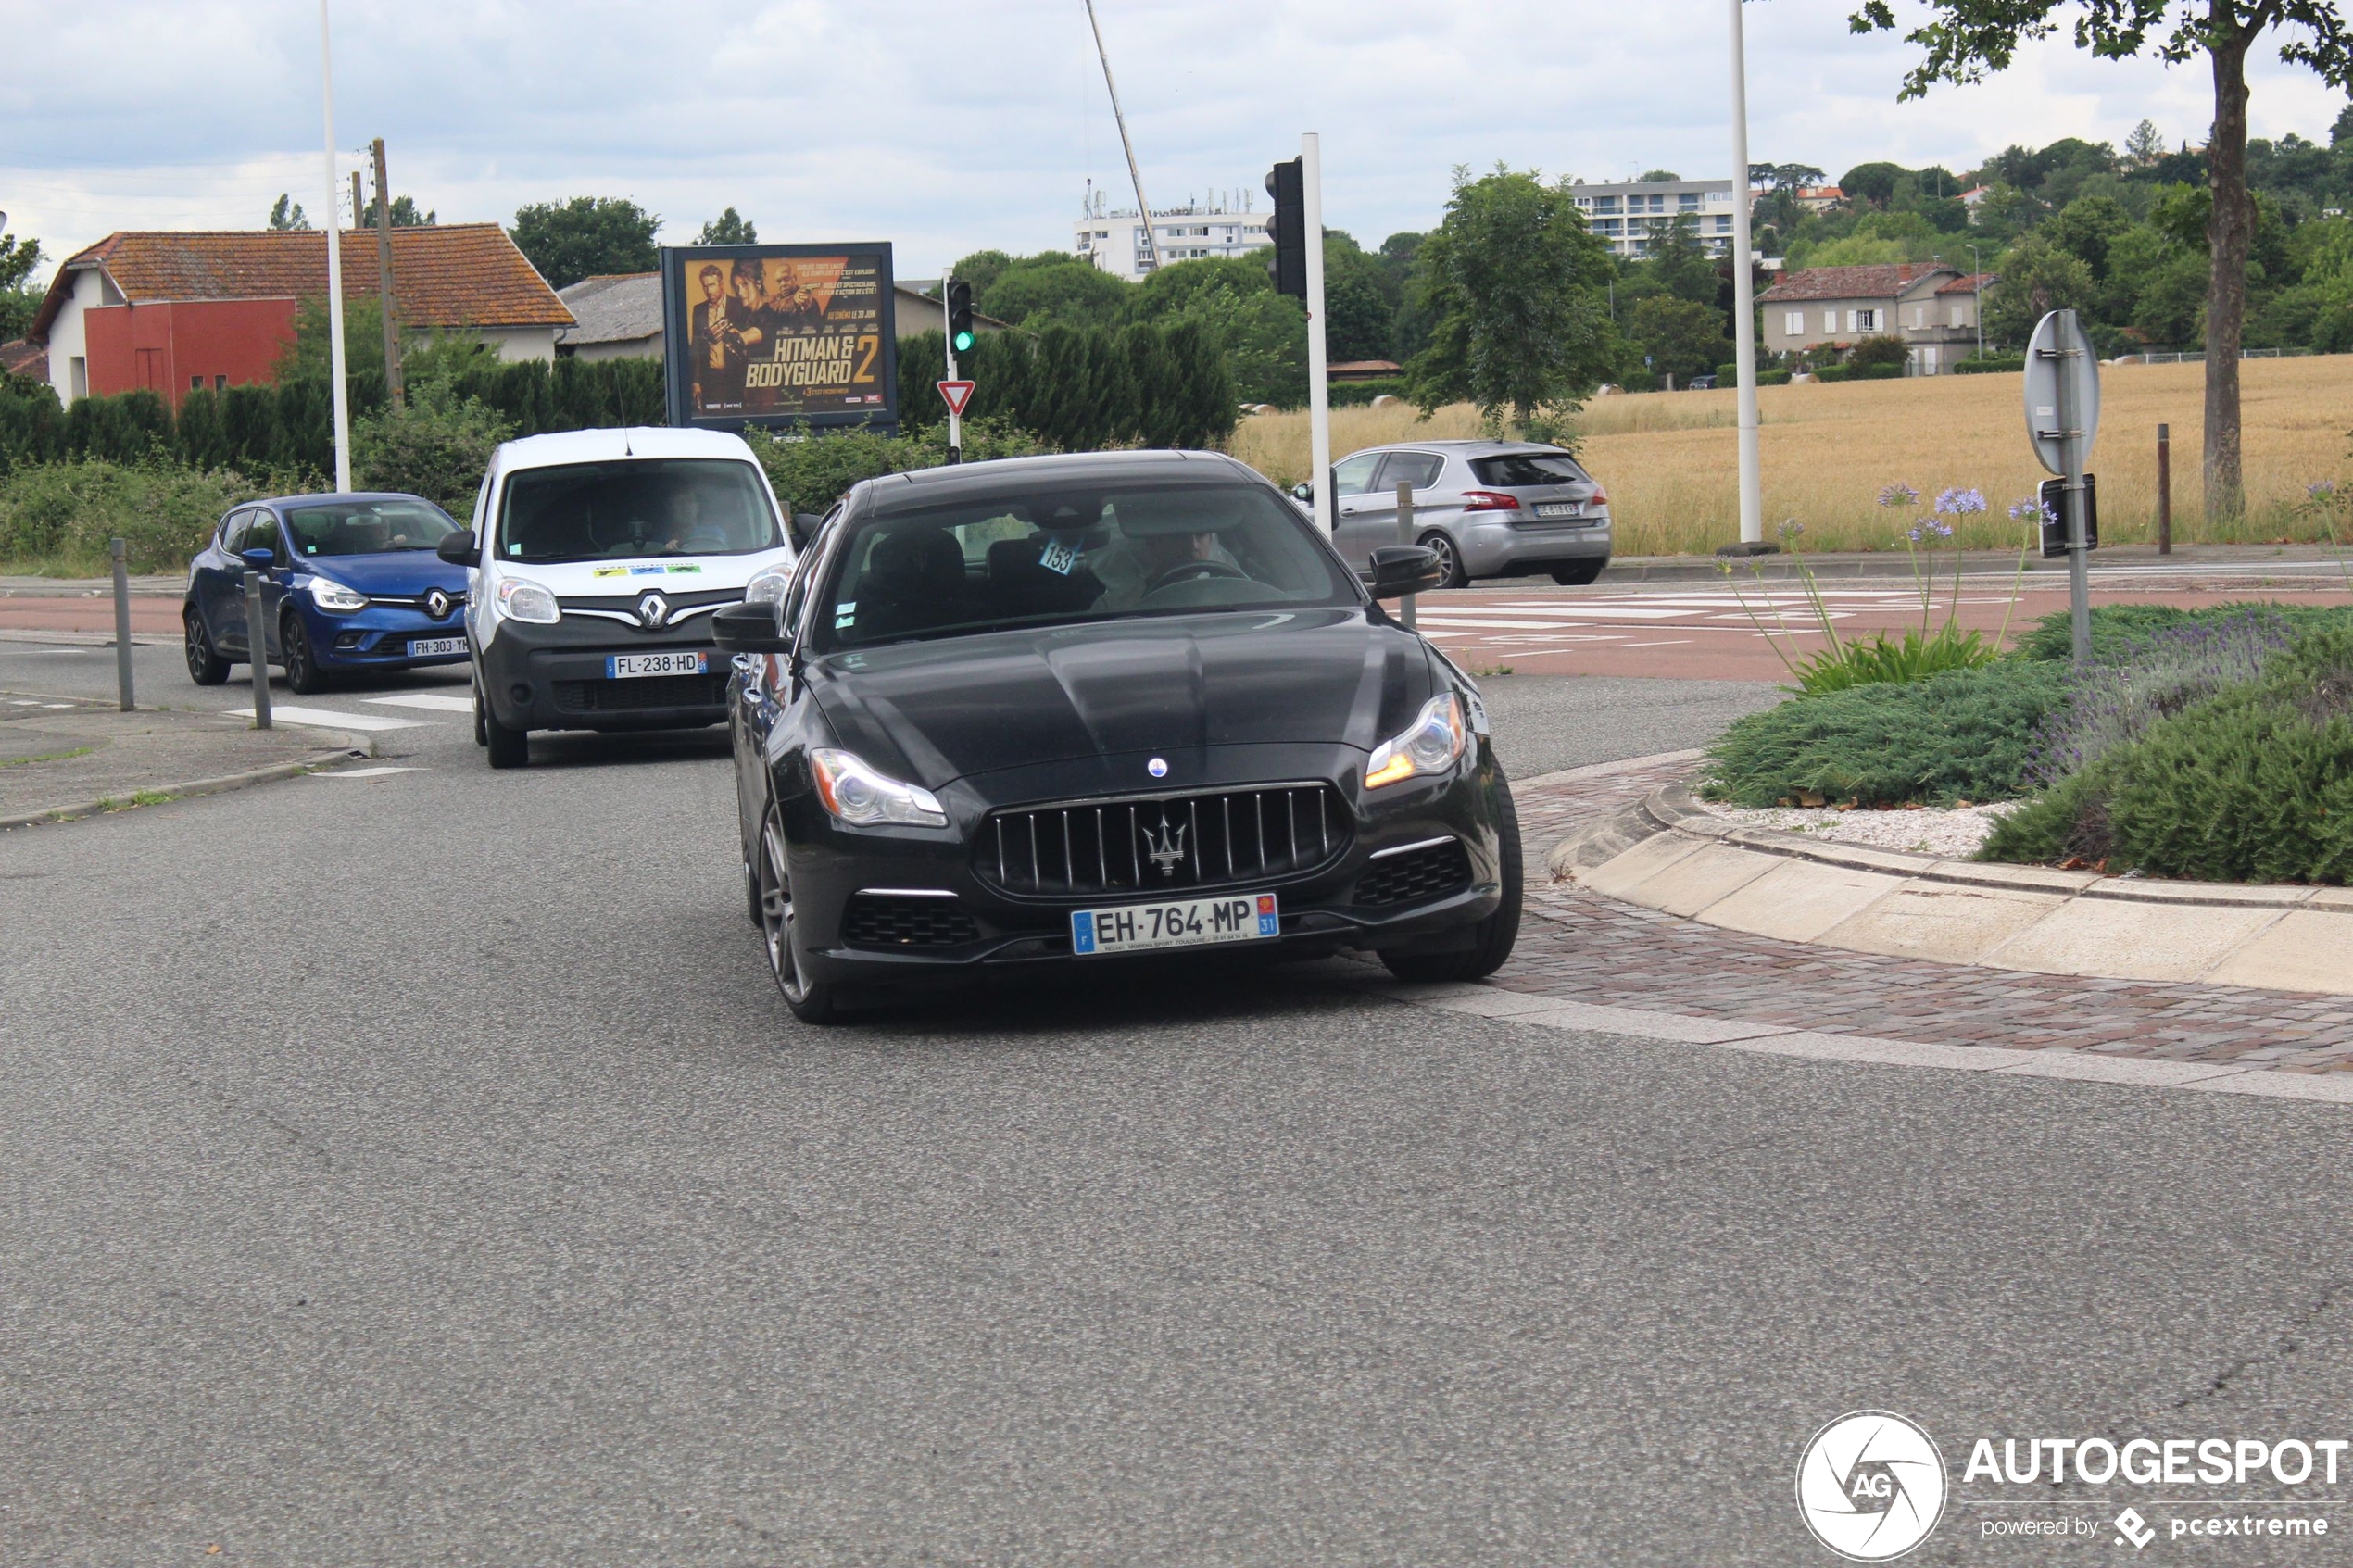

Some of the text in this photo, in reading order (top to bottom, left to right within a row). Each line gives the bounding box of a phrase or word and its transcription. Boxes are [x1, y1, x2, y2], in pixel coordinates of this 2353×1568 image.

[774, 336, 855, 362] HITMAN &
[853, 335, 878, 383] 2
[746, 361, 852, 387] BODYGUARD
[1046, 545, 1073, 572] 153
[618, 655, 697, 674] FL-238-HD
[1096, 900, 1251, 945] EH-764-MP
[1260, 918, 1275, 933] 31
[1081, 937, 1088, 946] F
